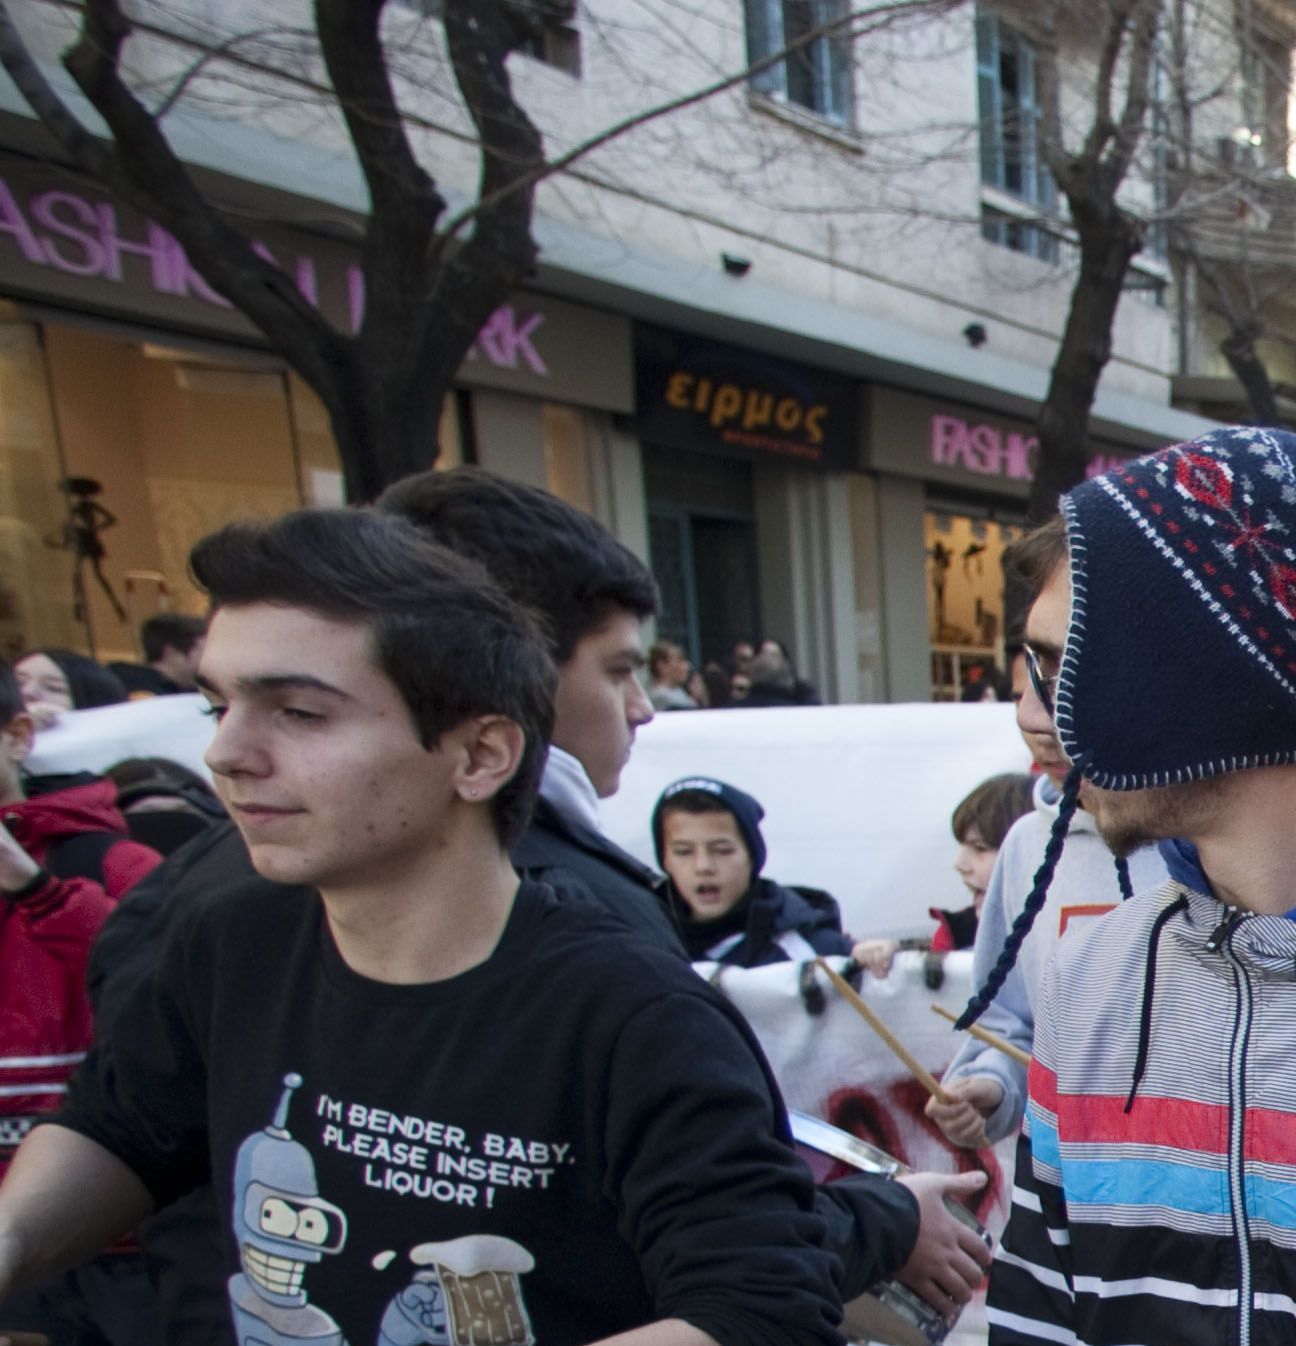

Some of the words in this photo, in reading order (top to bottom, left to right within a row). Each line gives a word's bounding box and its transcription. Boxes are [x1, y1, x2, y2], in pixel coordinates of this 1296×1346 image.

[667, 371, 828, 444] ειρμος
[317, 1094, 342, 1122] I'M
[323, 1124, 428, 1170] PLEASE
[437, 1152, 555, 1188] INSERT
